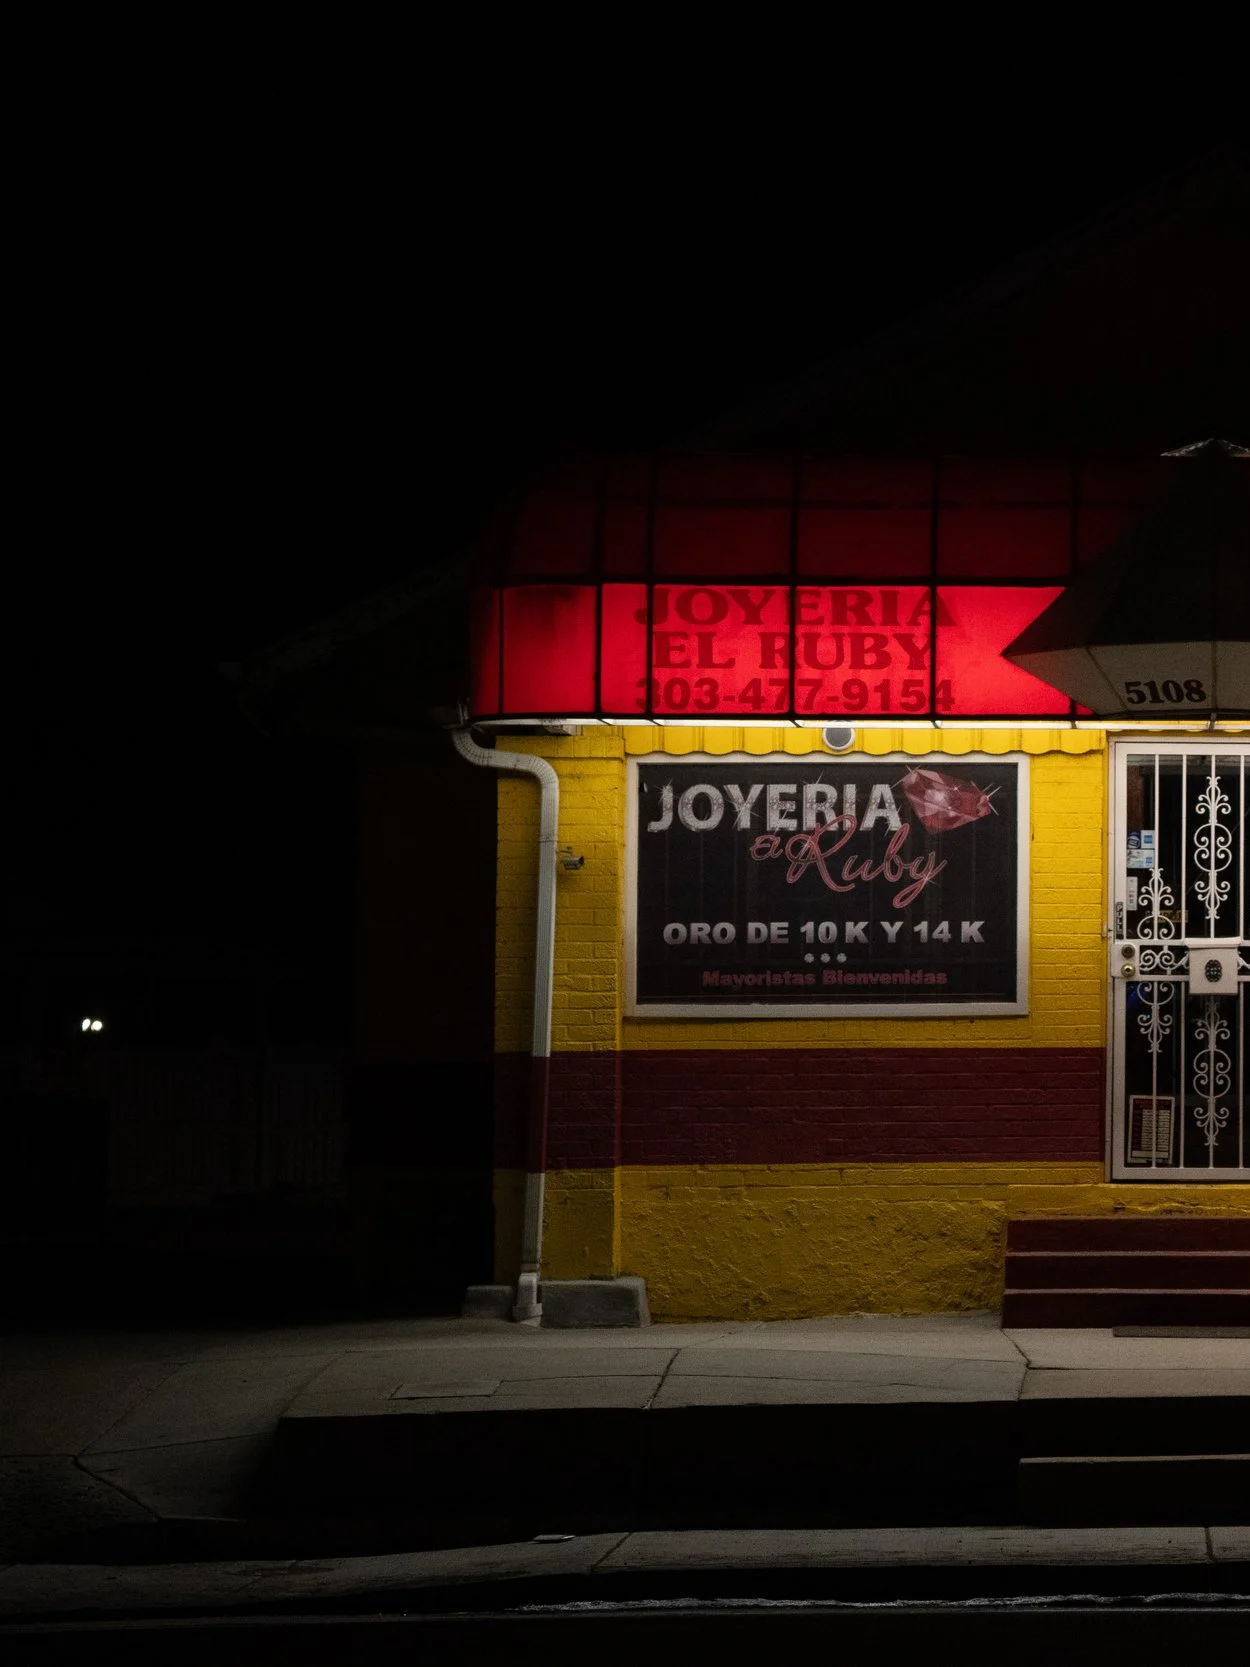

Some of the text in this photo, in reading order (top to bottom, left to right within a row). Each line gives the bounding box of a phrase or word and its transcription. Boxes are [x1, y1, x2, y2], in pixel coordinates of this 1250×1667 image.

[633, 587, 957, 627] JOYERIA
[652, 631, 938, 670] EL RUBY
[635, 677, 956, 712] 303-477-9154
[1124, 679, 1207, 705] 5108
[647, 783, 902, 832] JOYERIA
[785, 814, 948, 908] Ruby
[663, 922, 736, 945] ORO
[747, 922, 789, 944] DE
[880, 921, 904, 944] Y
[913, 921, 951, 944] 14
[960, 920, 985, 943] K
[703, 968, 948, 991] Mayoristas Bienvenidas
